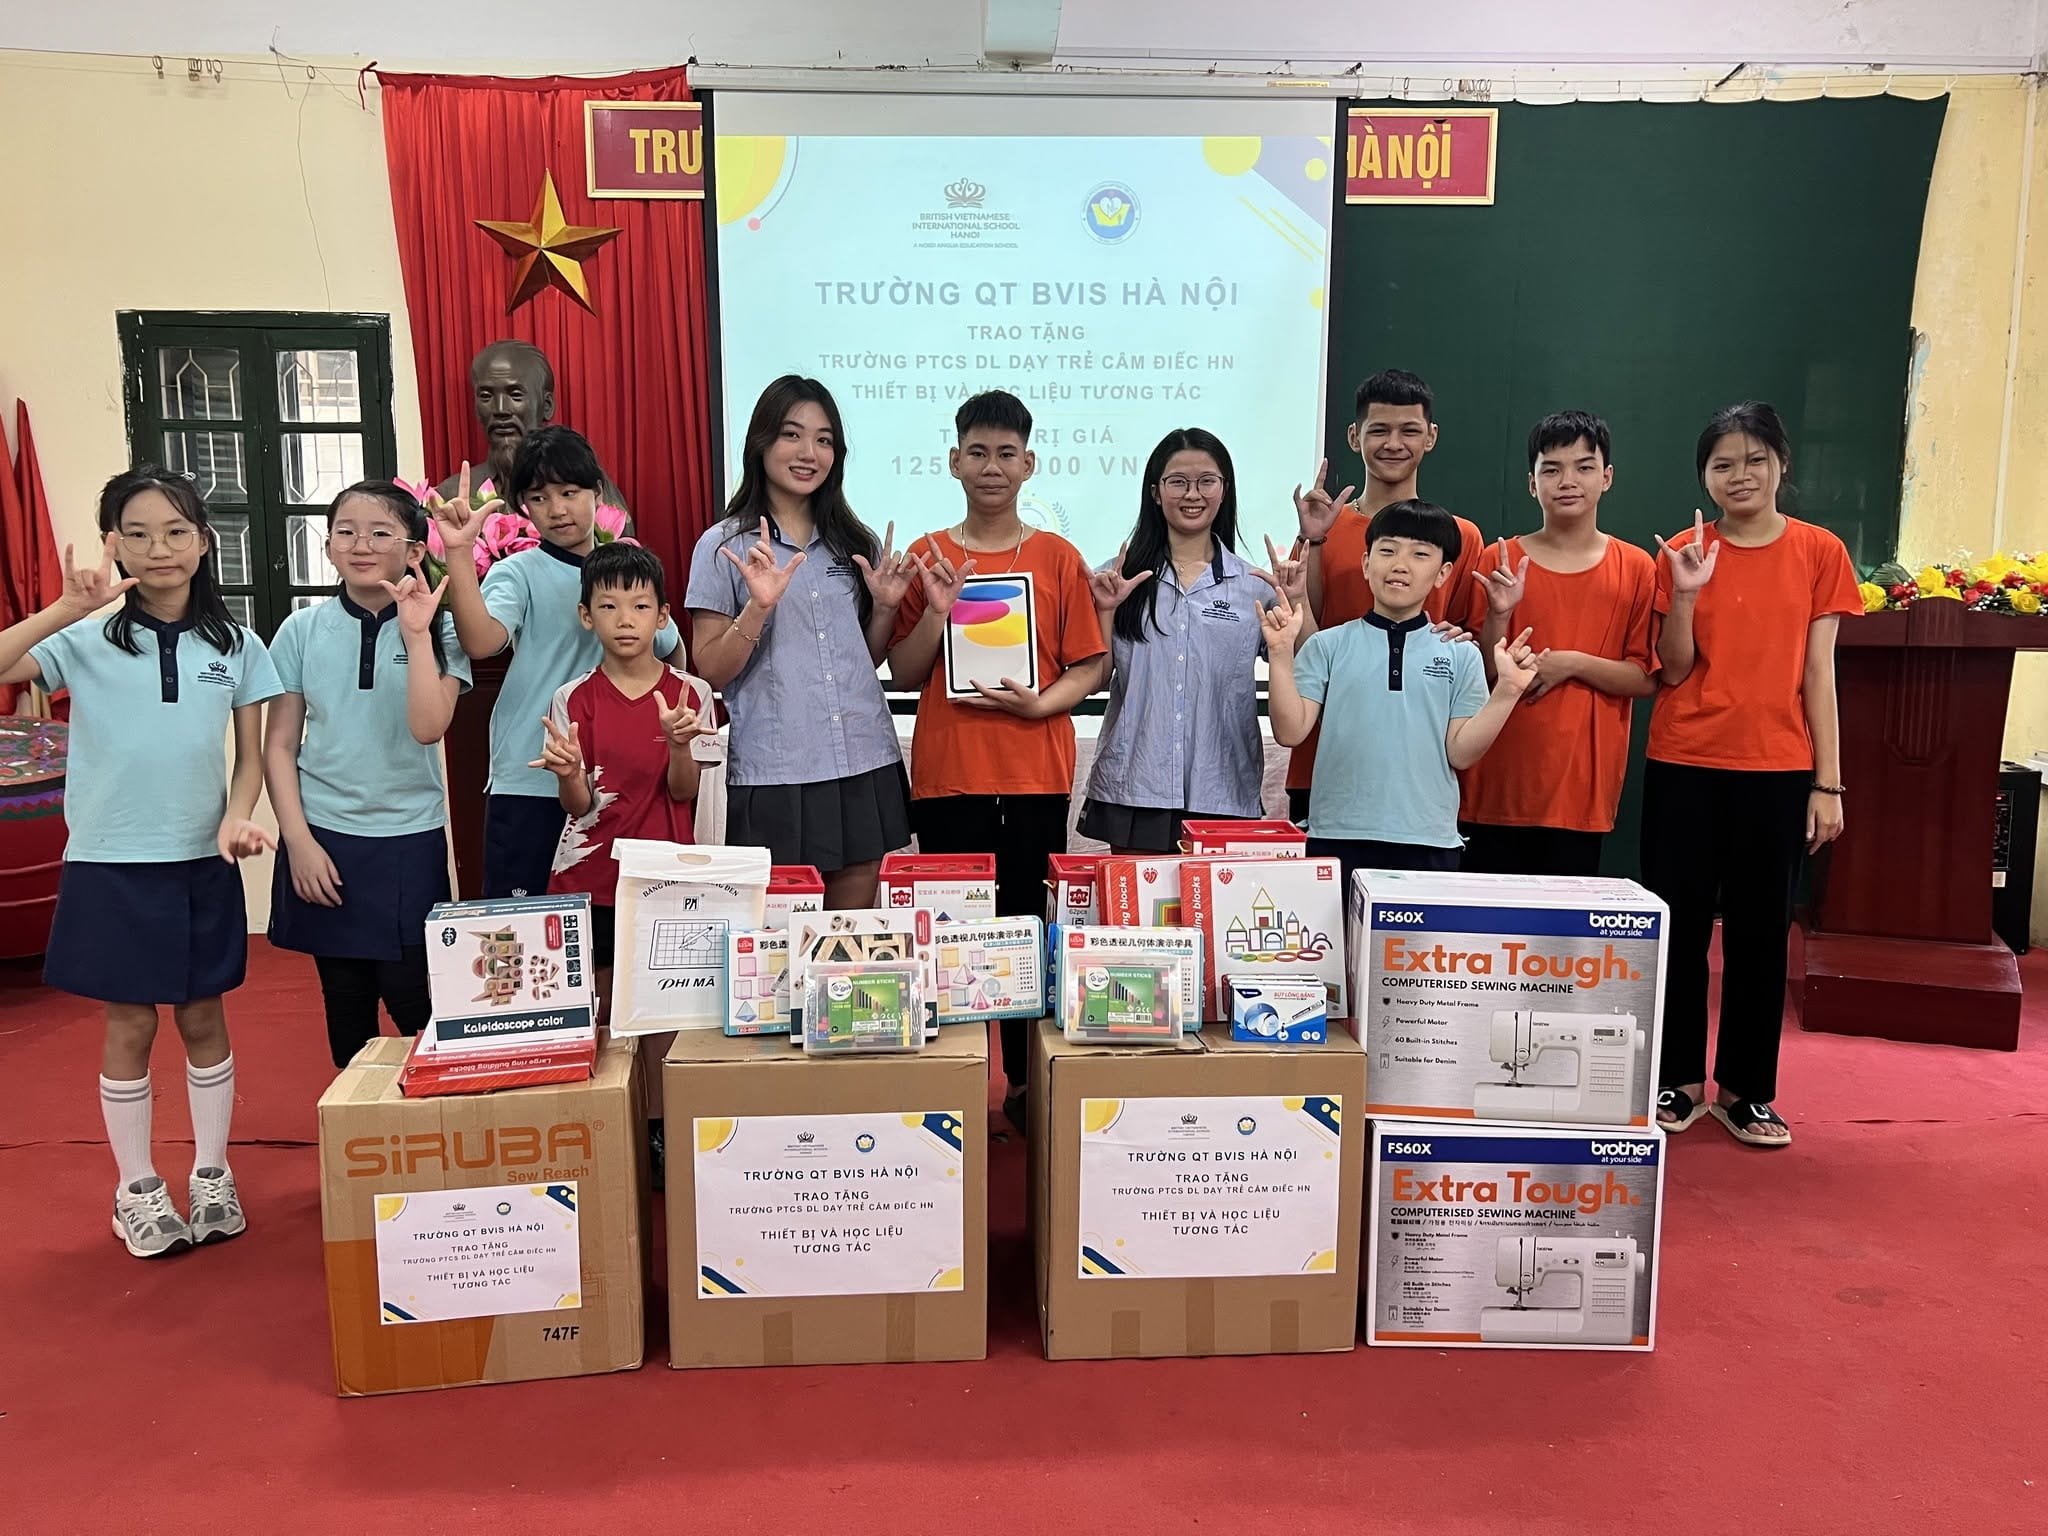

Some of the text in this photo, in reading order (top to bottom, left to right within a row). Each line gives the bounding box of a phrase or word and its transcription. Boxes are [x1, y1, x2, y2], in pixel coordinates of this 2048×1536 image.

[919, 213, 1010, 221] BRITISH VIETNAMESE
[912, 222, 1021, 230] INTERNATIONAL SCHOOL
[950, 231, 980, 239] HANOI
[814, 276, 1238, 311] TRƯỜNG QT BVIS HÀ NỘI
[967, 321, 1086, 343] TRAO TẶNG
[819, 350, 1234, 373] TRƯỜNG PTCS DL DẠY TRẺ CÂM ĐIẾC HN
[852, 380, 907, 399] THIẾT
[916, 385, 936, 402] BỊ
[944, 382, 969, 399] VÀ
[1030, 381, 1071, 402] LIỆU
[1080, 384, 1154, 399] TƯƠNG
[1162, 382, 1201, 399] TÁC
[1073, 425, 1114, 443] GIÁ
[1119, 876, 1128, 910] blocks
[1192, 876, 1202, 910] blocks
[1378, 910, 1424, 924] FS60X
[1589, 912, 1655, 929] brother
[1608, 929, 1625, 938] your
[1626, 928, 1643, 937] side
[1383, 938, 1641, 989] Extra Tough.
[1382, 977, 1574, 994] COMPUTERISED SEWING MACHINE
[1396, 998, 1417, 1007] Heavy
[1418, 998, 1435, 1008] Duty
[1436, 999, 1455, 1007] Metal
[463, 1015, 564, 1034] Kaleidoscope color
[1405, 1036, 1430, 1044] Built-in
[1431, 1038, 1458, 1046] Stitches
[478, 1062, 510, 1071] building
[1423, 1056, 1433, 1064] for
[1434, 1057, 1457, 1065] Denim
[1128, 1148, 1297, 1162] TRƯỜNG QT BVIS HÀ NỘI
[1388, 1142, 1432, 1155] FS60X
[1591, 1141, 1654, 1157] brother
[507, 1165, 589, 1183] Sew Reach
[744, 1165, 919, 1181] TRƯỜNG QT BVIS HÀ NỘI
[1175, 1171, 1249, 1185] TRAO TẶNG
[794, 1189, 870, 1202] TRAO TẶNG
[1112, 1186, 1155, 1195] TRƯỜNG
[1158, 1187, 1184, 1195] PTCS
[1272, 1183, 1294, 1193] ĐIẾC
[1297, 1184, 1311, 1192] HN
[1393, 1169, 1641, 1213] Extra Tough.
[729, 1205, 773, 1214] TRƯỜNG
[777, 1205, 803, 1213] PTCS
[823, 1204, 843, 1214] DẠY
[894, 1200, 916, 1210] ĐIẾC
[920, 1201, 934, 1209] HN
[1391, 1207, 1576, 1219] COMPUTERISED SEWING MACHINE
[1141, 1207, 1281, 1223] THIẾT BỊ VÀ HỌC LIỆU
[413, 1230, 459, 1241] TRƯỜNG
[463, 1228, 477, 1237] QT
[480, 1226, 505, 1235] BVIS
[526, 1222, 545, 1232] NỘI
[760, 1225, 903, 1240] THIẾT BỊ VÀ HỌC LIỆU
[1173, 1223, 1249, 1235] TƯƠNG TÁC
[451, 1244, 478, 1253] TRAO
[793, 1241, 871, 1254] TƯƠNG TÁC
[458, 1271, 469, 1280] BỊ
[513, 1264, 535, 1274] LIỆU
[452, 1280, 488, 1290] TƯƠNG
[542, 1326, 580, 1342] 747F
